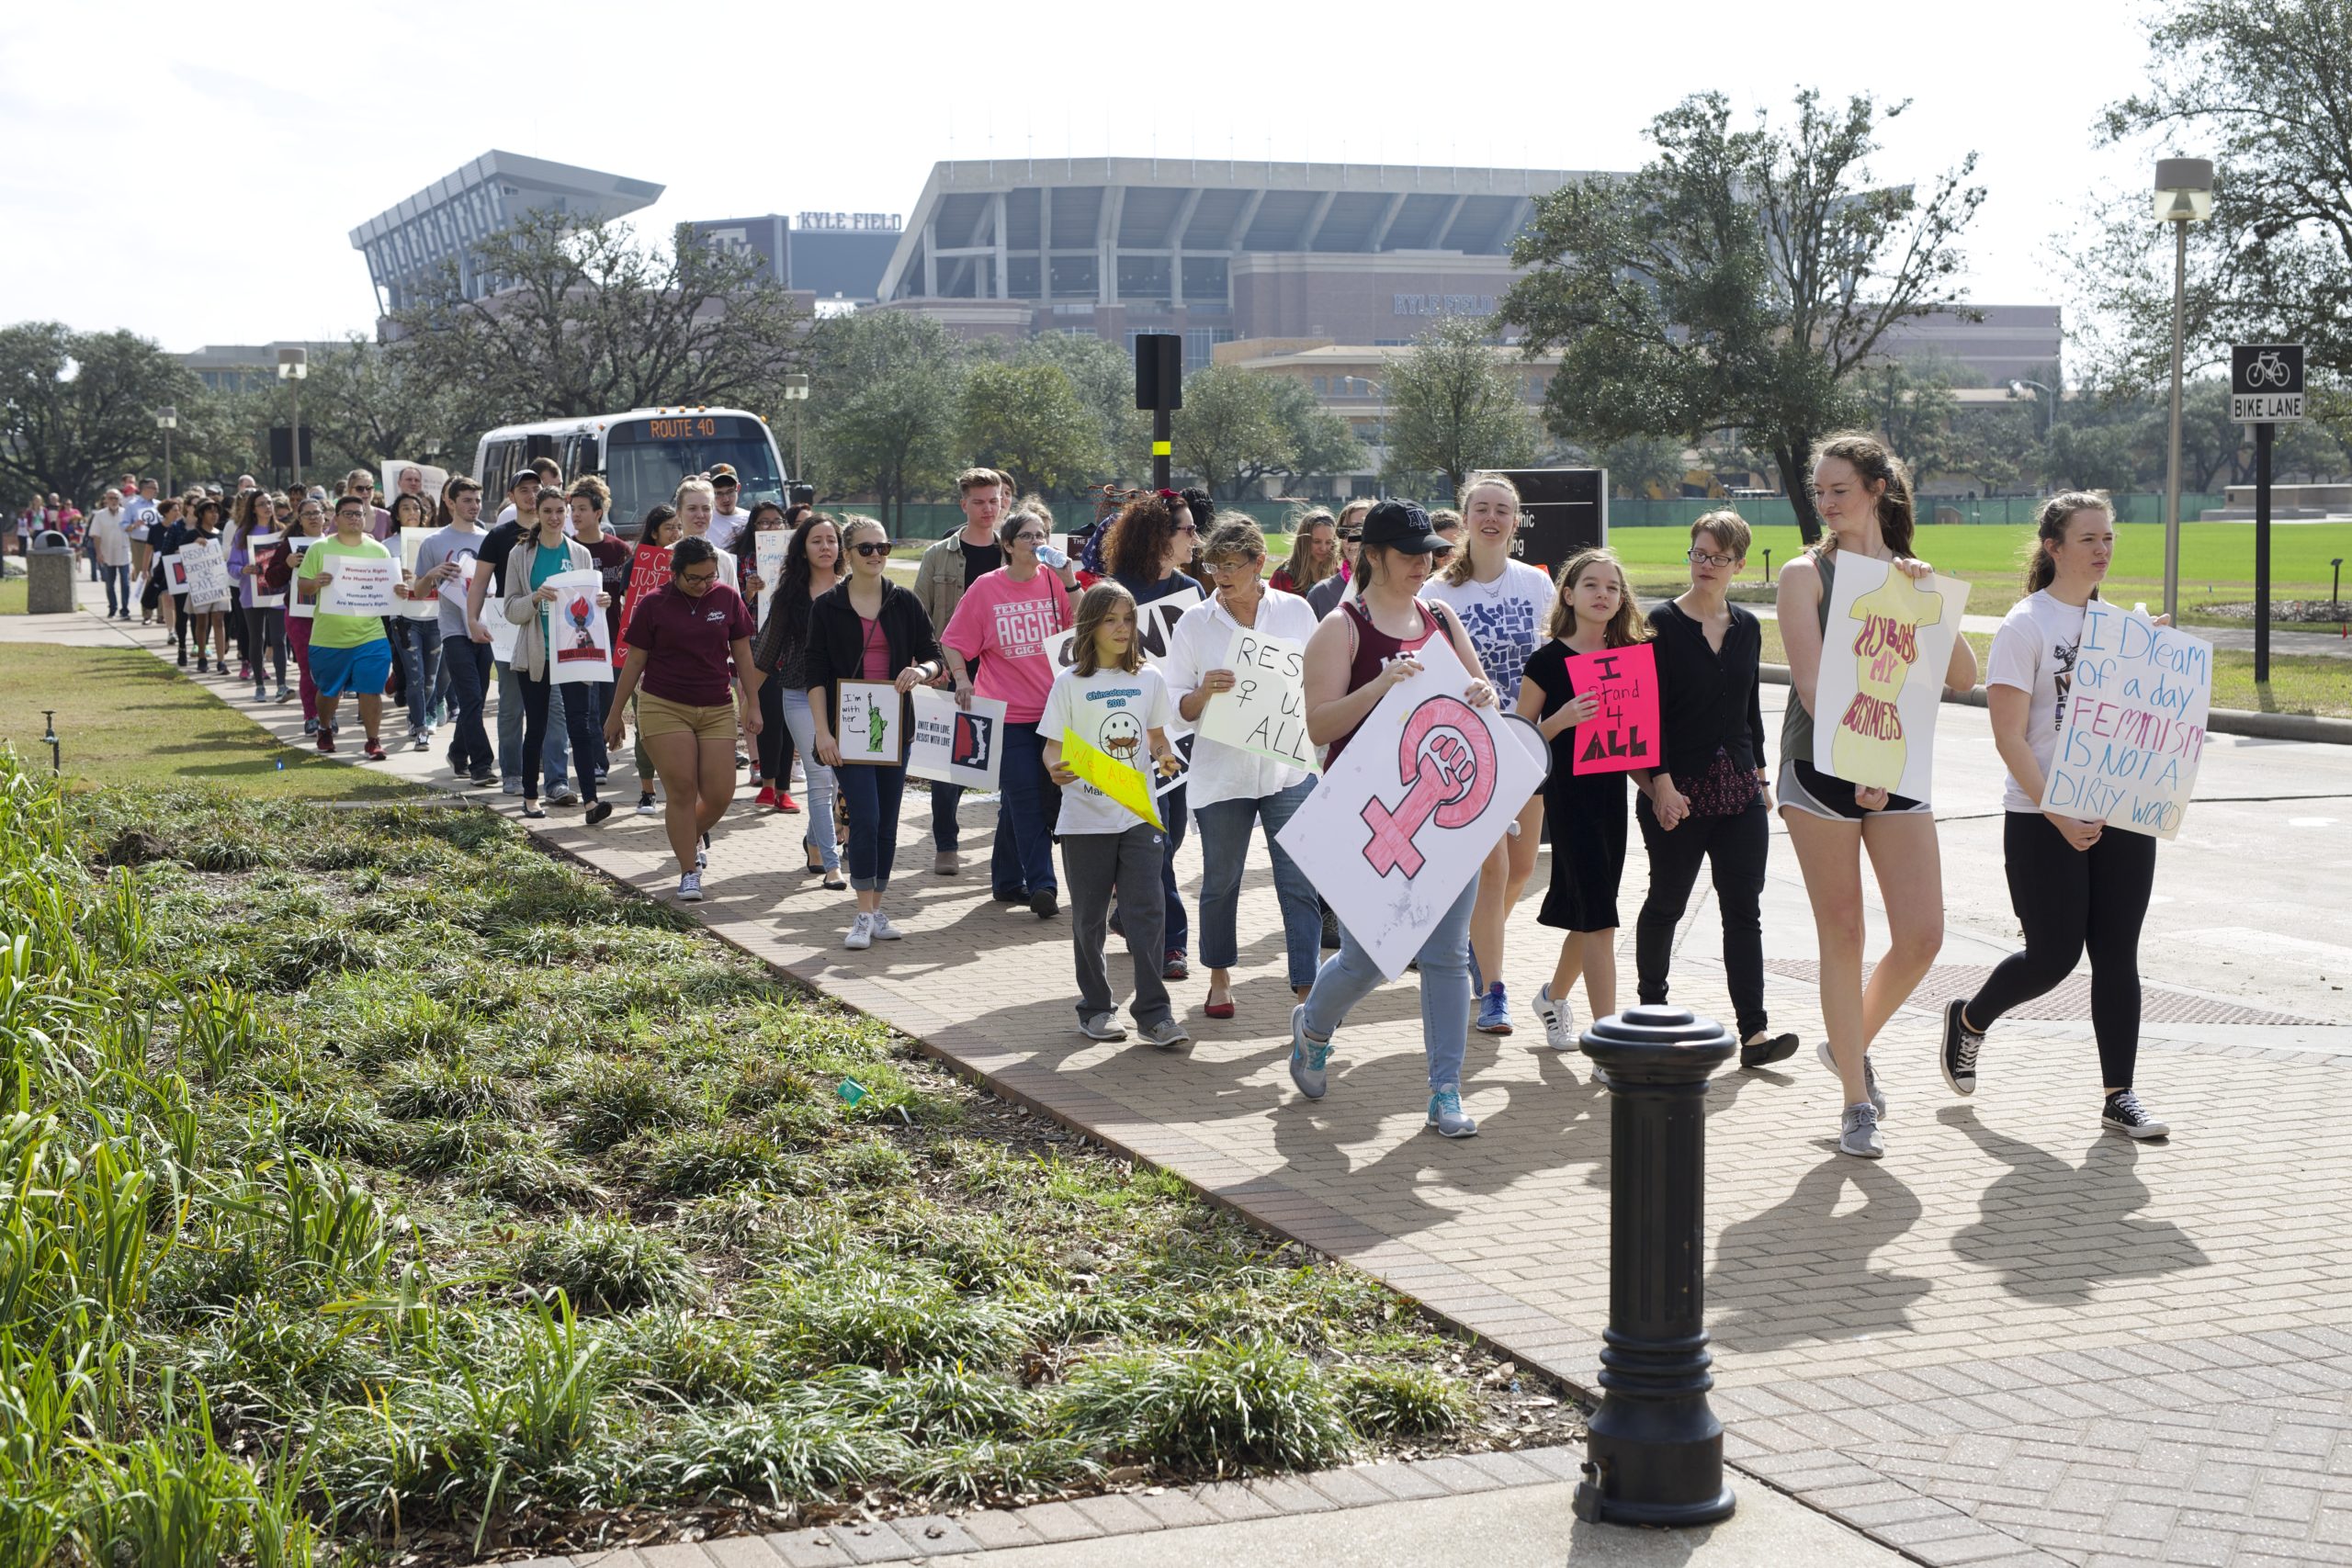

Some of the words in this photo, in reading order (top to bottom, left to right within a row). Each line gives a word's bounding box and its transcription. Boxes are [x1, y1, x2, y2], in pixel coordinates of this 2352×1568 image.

[800, 211, 846, 230] KYLE
[853, 212, 901, 231] FIELD
[1394, 294, 1440, 314] KYLE
[1443, 294, 1493, 314] FIELD
[2234, 399, 2263, 417] BIKE
[2268, 398, 2301, 416] LANE
[650, 419, 693, 438] ROUTE
[696, 418, 715, 436] 40
[758, 535, 777, 546] THE
[629, 566, 666, 589] JUST
[992, 603, 1034, 615] TEXAS
[2083, 611, 2109, 650] I
[1014, 645, 1035, 656] GIG
[1237, 637, 1305, 684] RES
[1593, 656, 1622, 681] I
[1869, 650, 1899, 683] MY
[842, 694, 862, 703] I'm
[1086, 688, 1142, 702] Chincoteague
[1106, 698, 1126, 708] 2016
[2123, 678, 2142, 699] a
[2150, 673, 2194, 721] day
[842, 705, 861, 714] with
[842, 715, 856, 723] her
[1607, 705, 1623, 729] 4
[1842, 692, 1902, 740] BUSINESS
[917, 720, 929, 730] UNITE
[930, 722, 940, 733] WITH
[2072, 695, 2204, 763] FEMINISM
[916, 732, 930, 744] RESIST
[930, 734, 941, 745] WITH
[1246, 716, 1307, 762] ALL
[1579, 725, 1648, 762] ALL
[2064, 725, 2091, 767] IS
[2097, 742, 2162, 781] NOT
[2154, 759, 2177, 791] A
[2049, 770, 2126, 819] DIRTY
[2132, 795, 2181, 831] WORD
